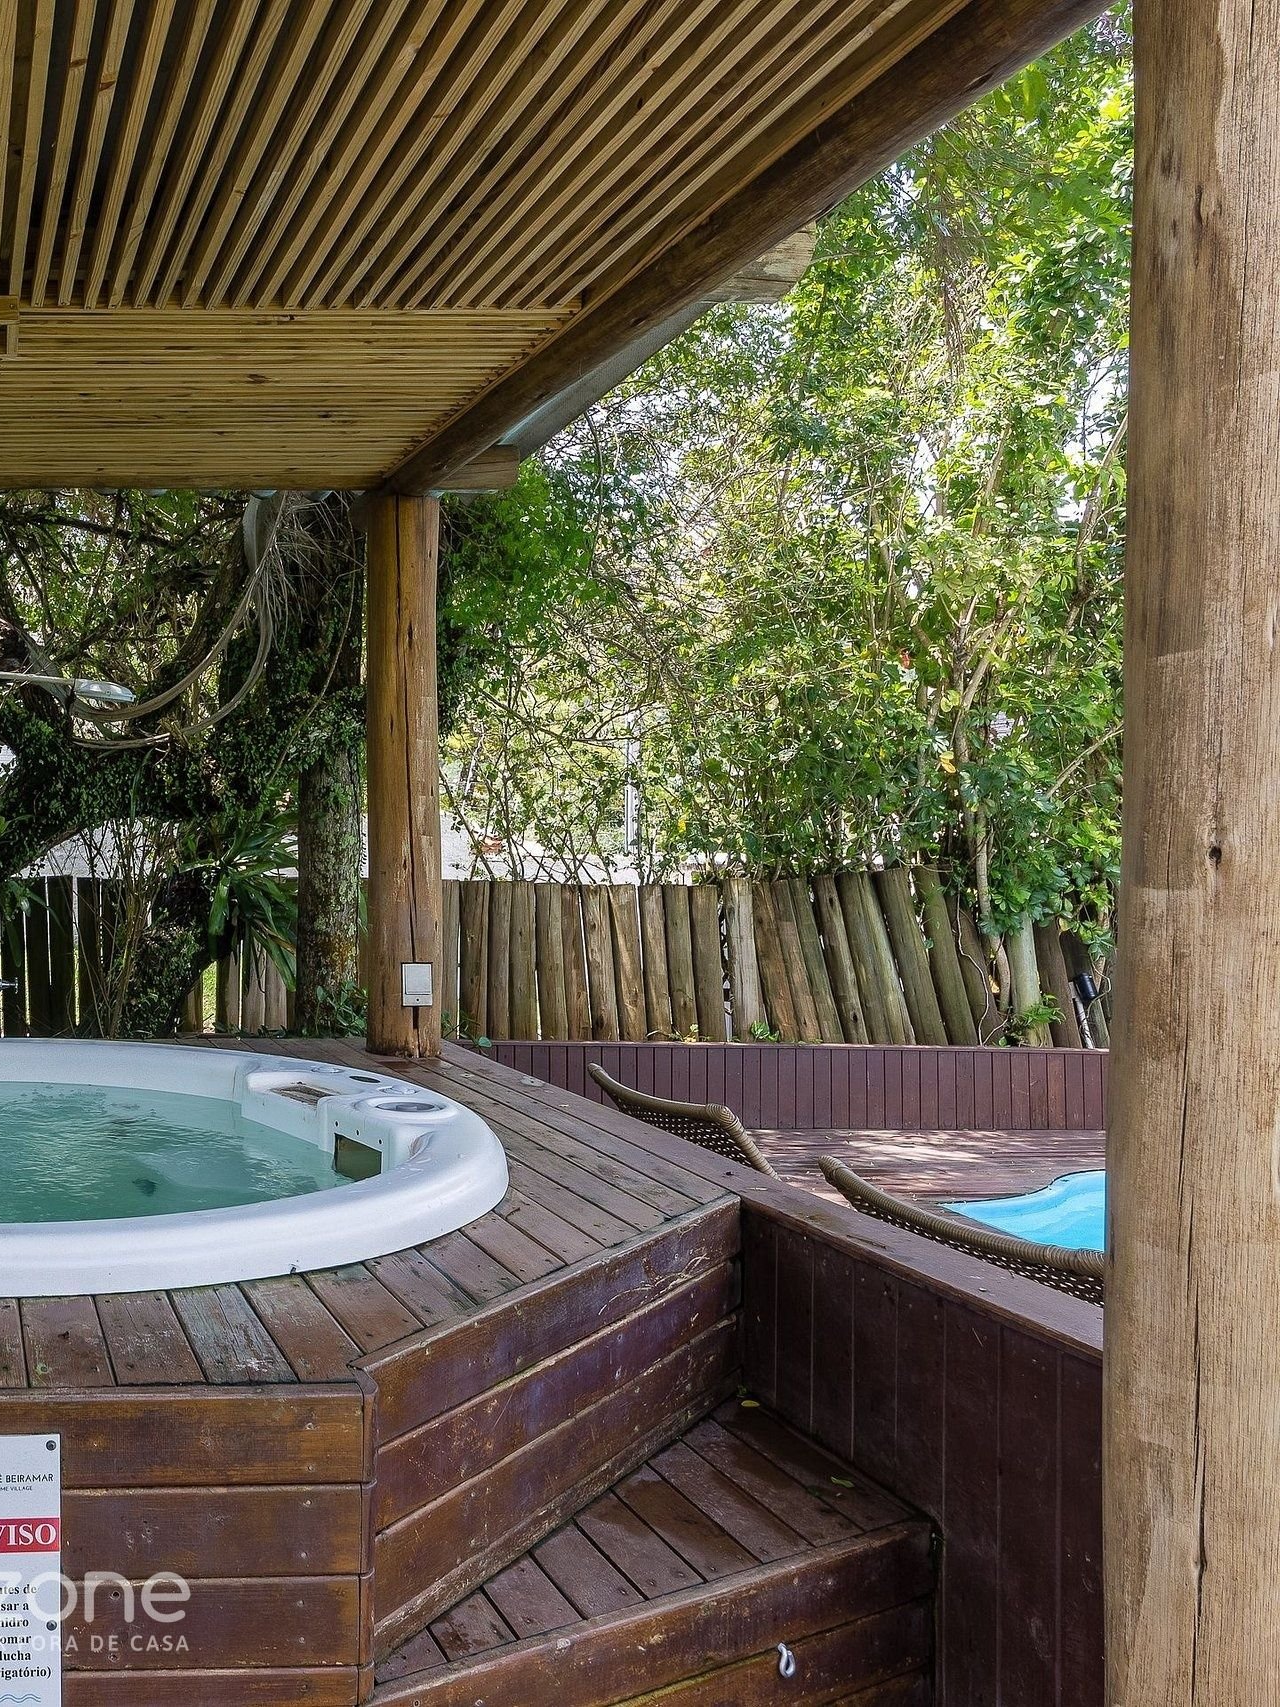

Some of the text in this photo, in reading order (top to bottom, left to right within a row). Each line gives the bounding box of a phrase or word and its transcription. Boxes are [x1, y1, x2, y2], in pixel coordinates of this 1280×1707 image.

[5, 1473, 54, 1483] BEIRAMAR
[23, 1584, 37, 1594] de
[22, 1602, 30, 1611] a
